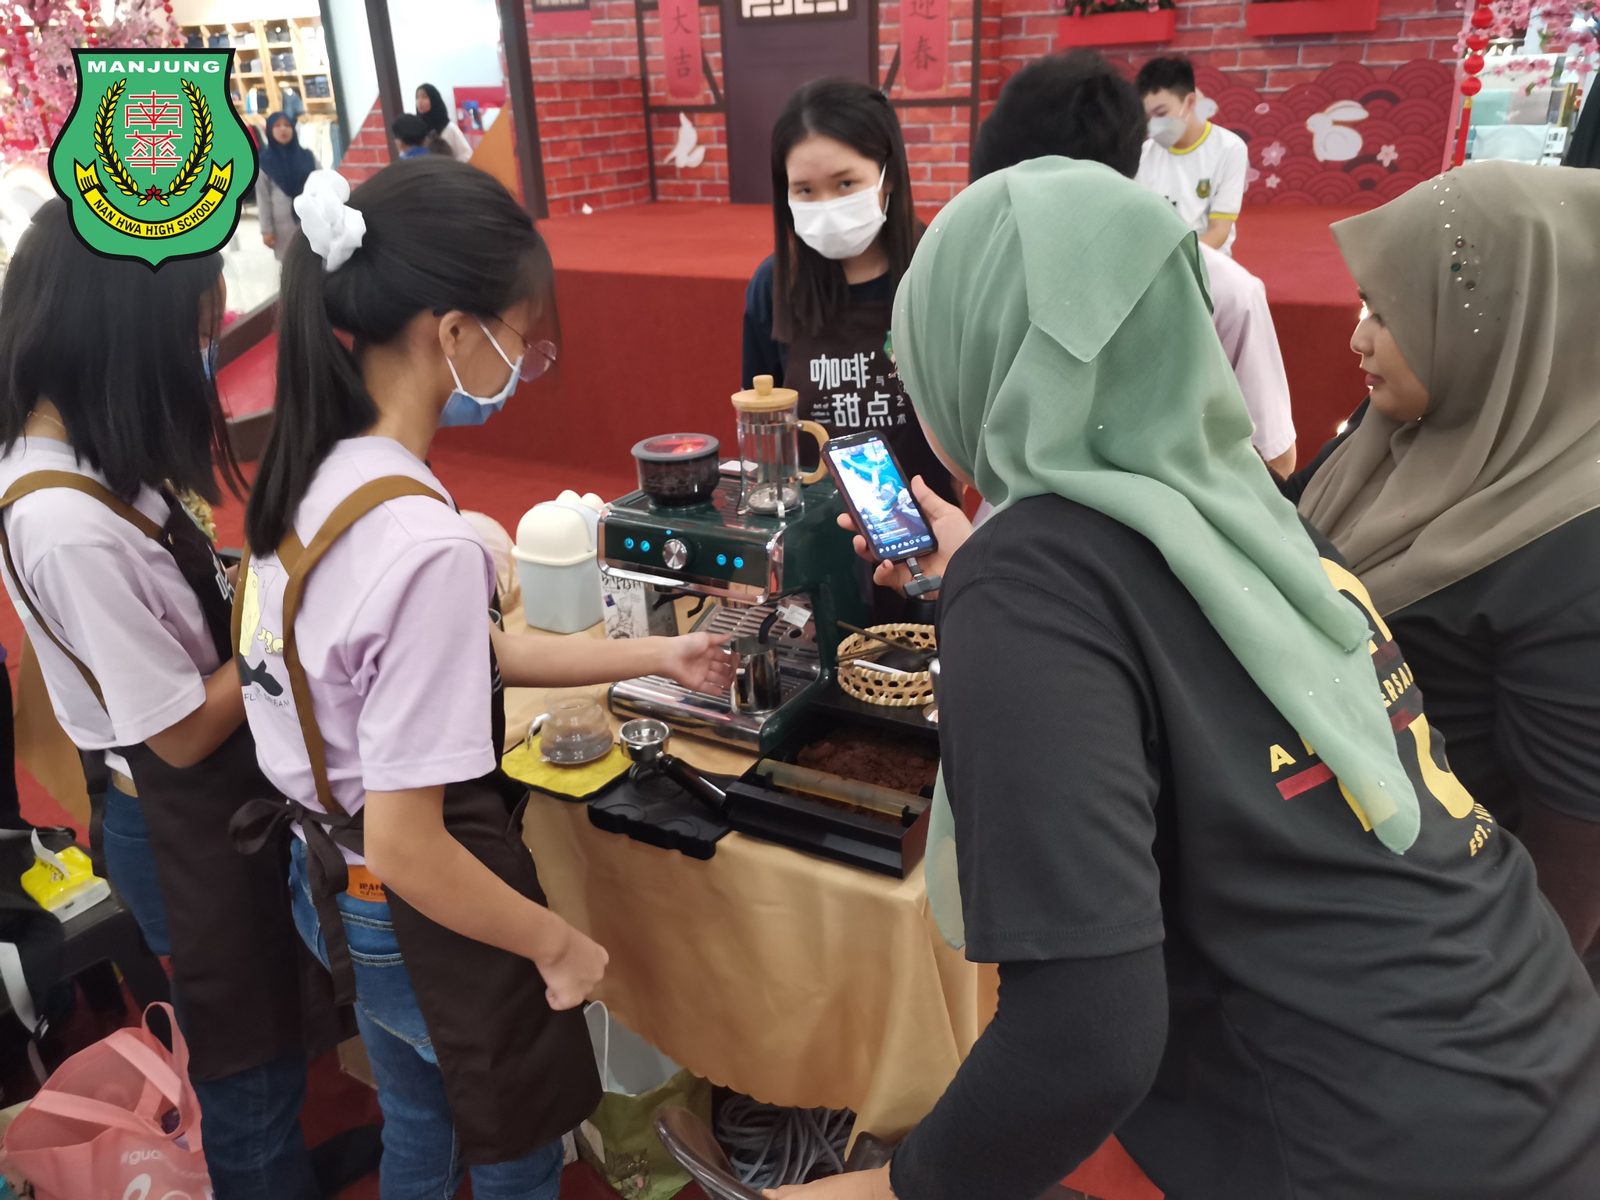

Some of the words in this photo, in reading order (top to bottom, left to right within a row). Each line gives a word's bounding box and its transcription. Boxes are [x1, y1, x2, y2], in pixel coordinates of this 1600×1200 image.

[672, 5, 692, 78] 大吉
[810, 353, 871, 390] 咖啡
[831, 391, 893, 427] 甜点
